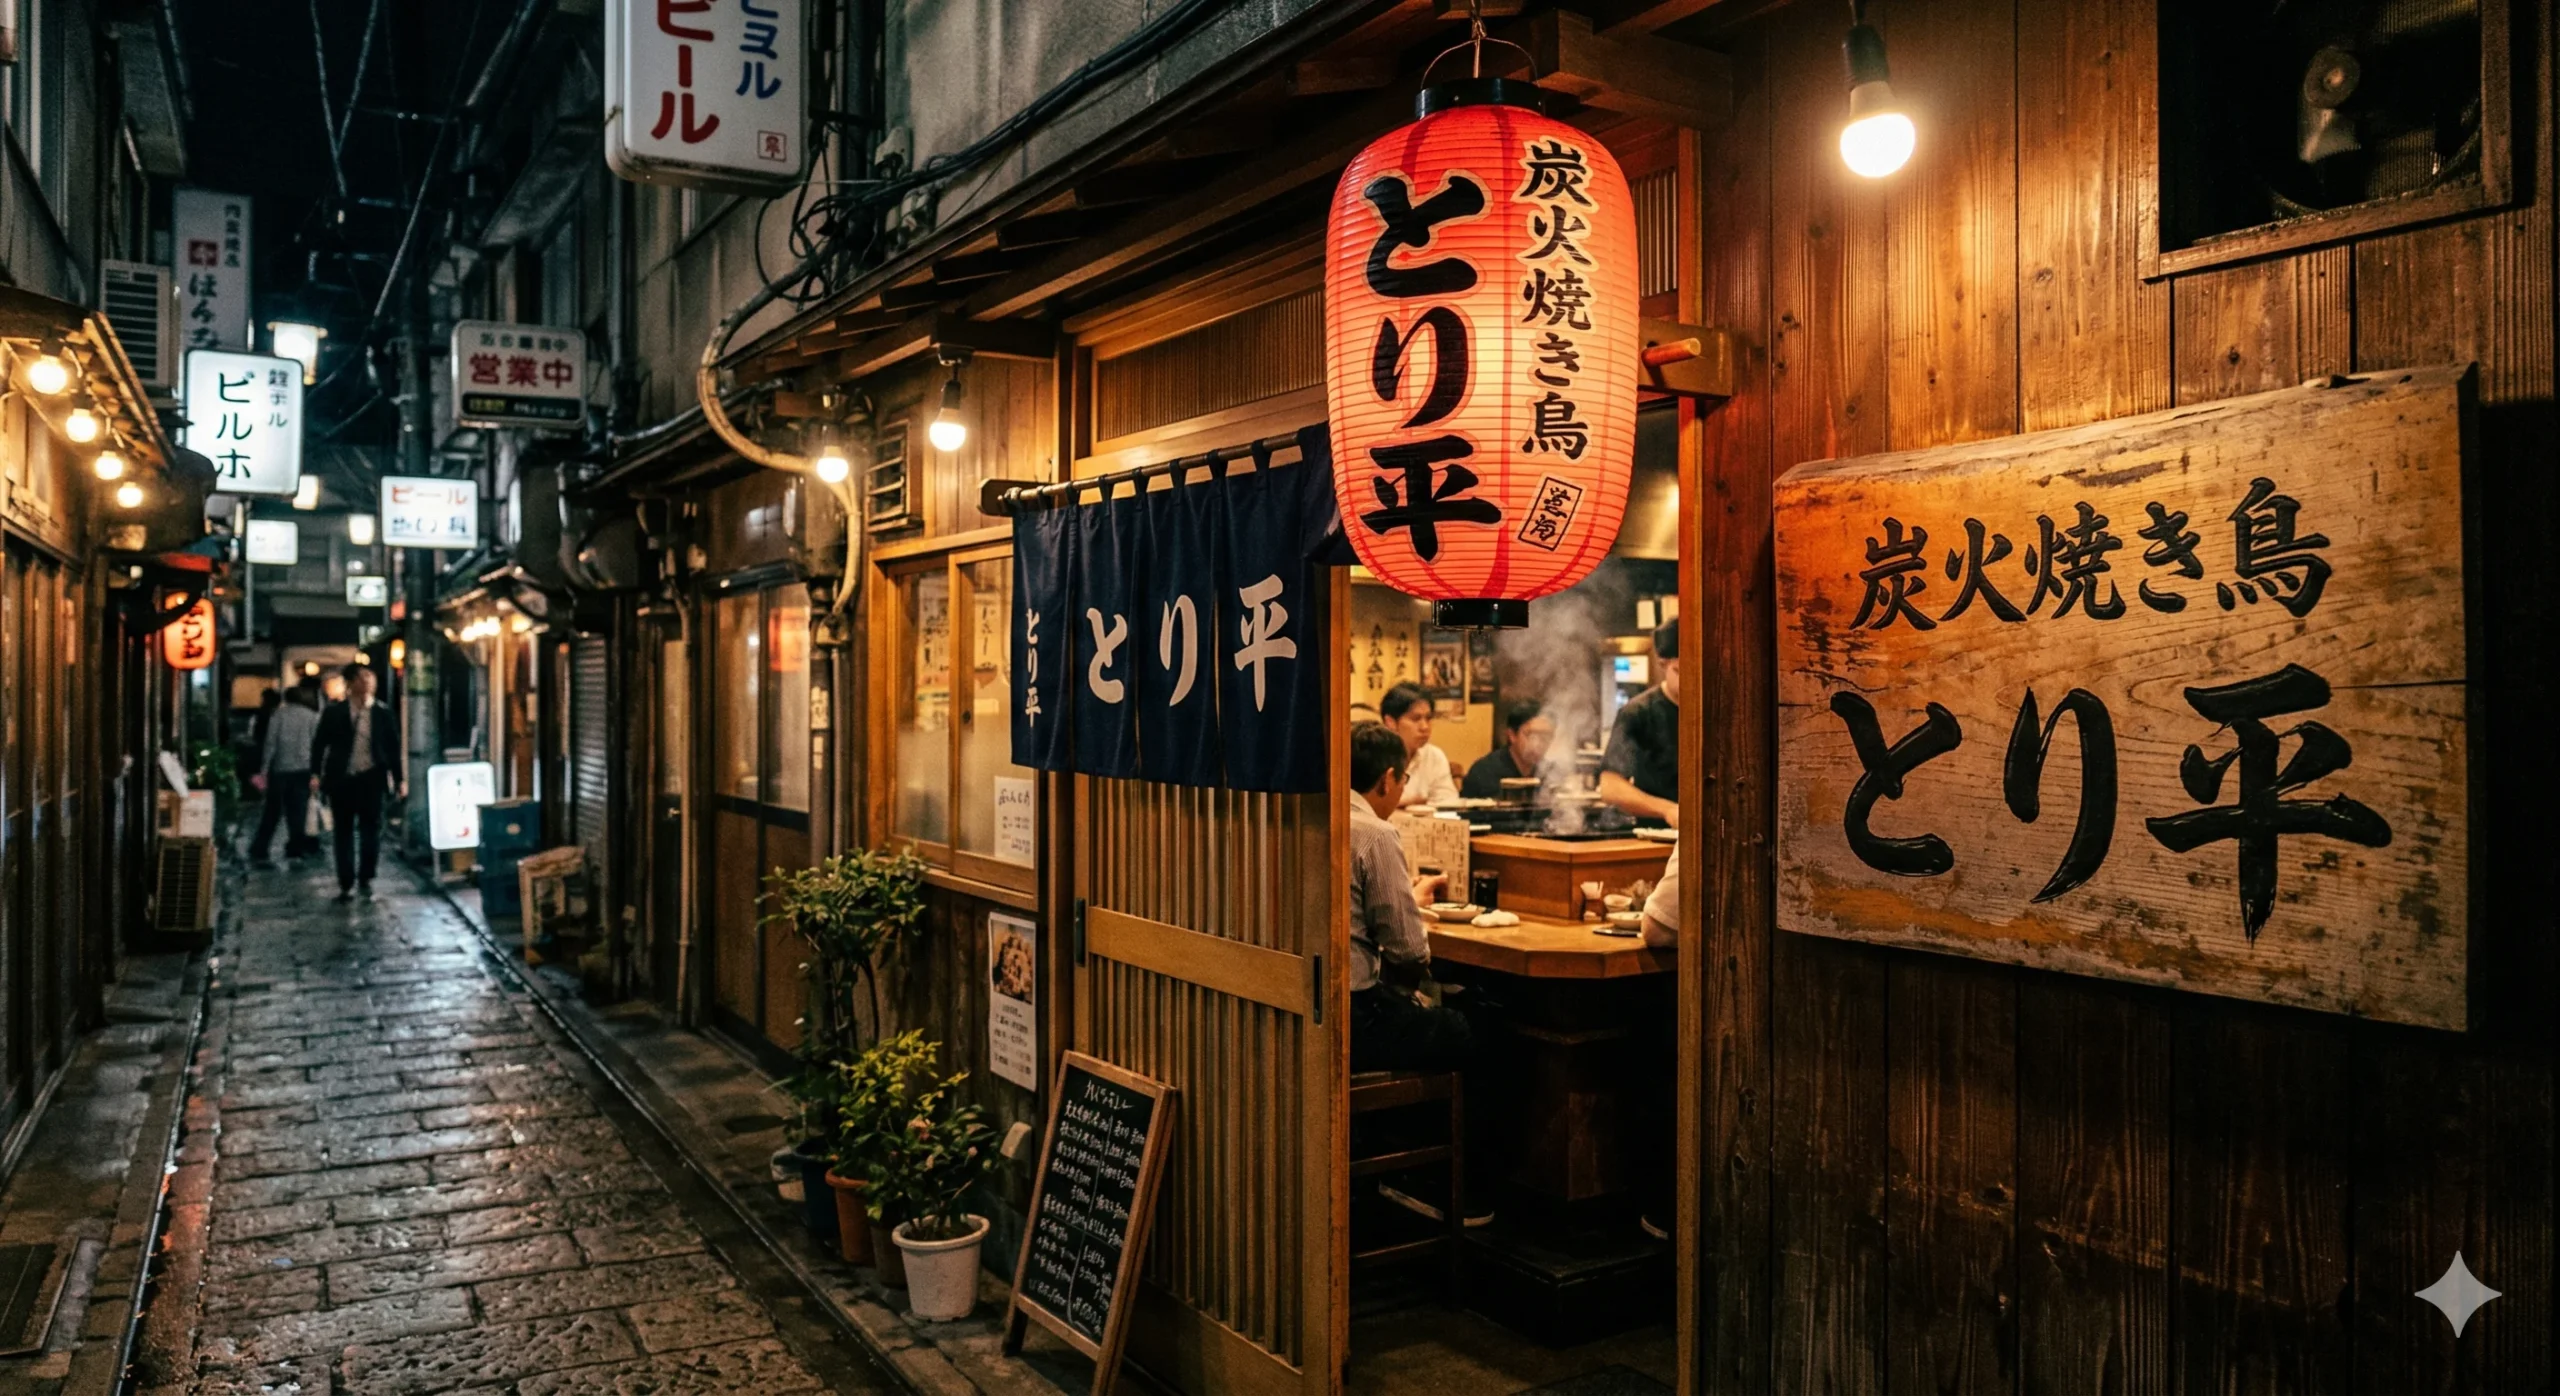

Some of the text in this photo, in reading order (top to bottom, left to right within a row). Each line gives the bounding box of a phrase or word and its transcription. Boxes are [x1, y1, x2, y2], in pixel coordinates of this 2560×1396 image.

[469, 353, 573, 389] 営業中
[1360, 175, 1502, 563] とり平
[1520, 141, 1593, 461] 炭火焼き鳥
[216, 370, 255, 479] ビルホ
[1849, 476, 2333, 631] 炭火焼き鳥
[1026, 608, 1041, 728] とり平
[1086, 573, 1298, 713] とり平
[1830, 662, 2393, 948] とり平
